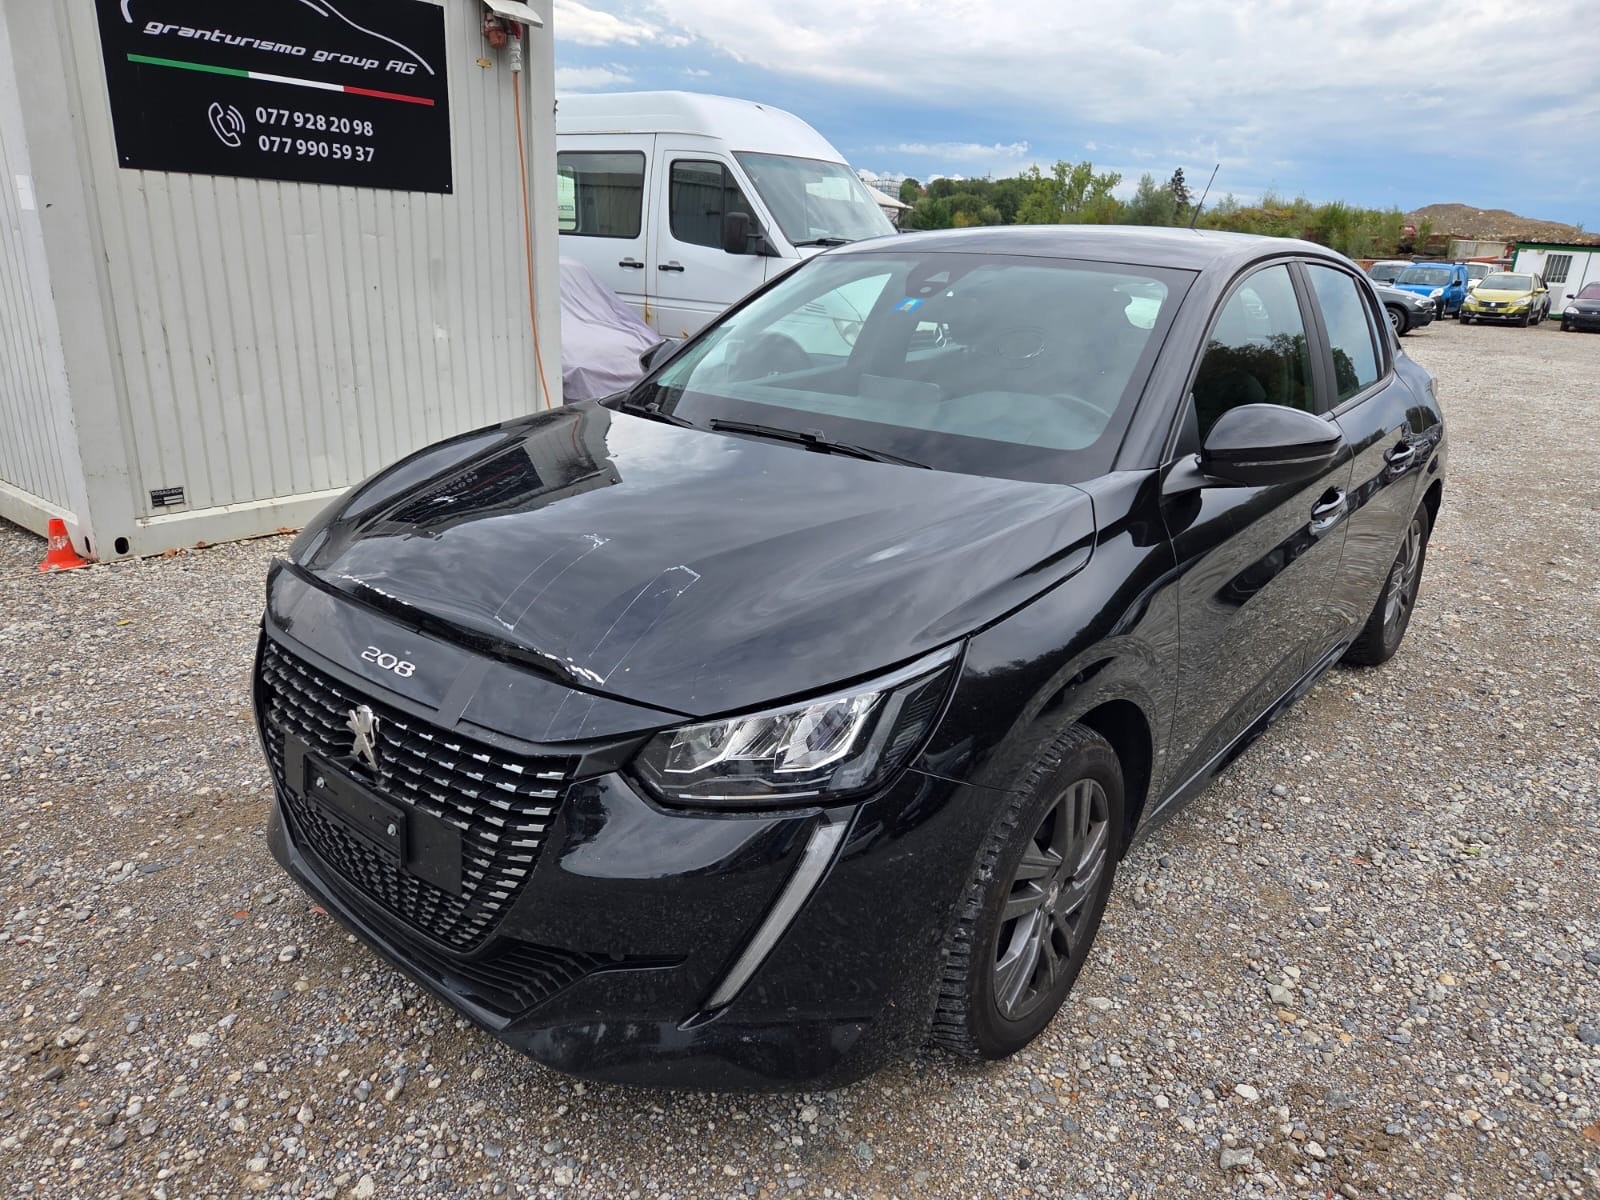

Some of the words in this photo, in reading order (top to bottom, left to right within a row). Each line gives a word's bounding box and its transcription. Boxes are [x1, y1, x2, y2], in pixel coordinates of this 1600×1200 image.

[143, 21, 307, 57] granturismo
[312, 49, 380, 71] group
[385, 59, 419, 76] AG
[255, 106, 290, 126] 077
[293, 111, 327, 131] 928
[329, 116, 350, 134] 20
[352, 119, 374, 137] 98
[258, 135, 292, 154] 077
[295, 139, 329, 158] 990
[332, 143, 352, 160] 59
[355, 145, 375, 162] 37
[361, 645, 416, 678] 208
